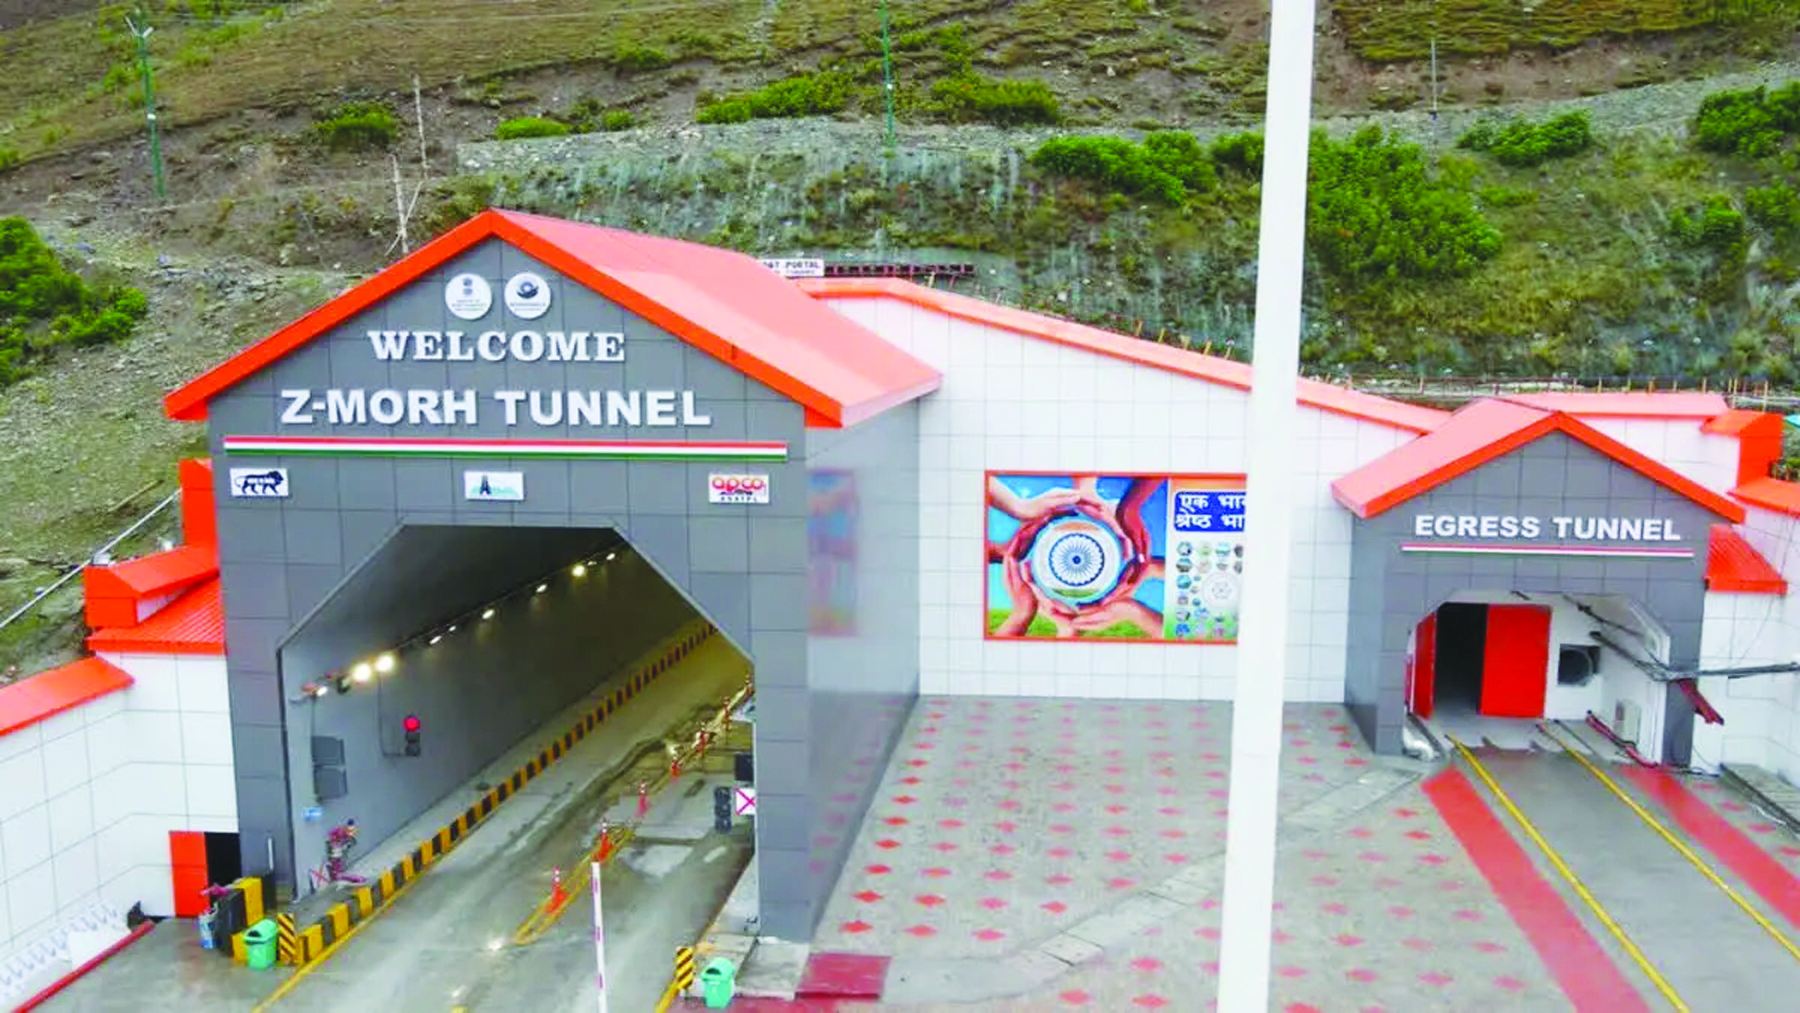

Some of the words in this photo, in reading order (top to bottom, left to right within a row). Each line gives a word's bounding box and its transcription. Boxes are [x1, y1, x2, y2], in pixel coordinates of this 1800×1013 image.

[785, 261, 820, 269] PORTAL
[368, 330, 626, 362] WELCOME
[280, 389, 478, 425] Z-MORH
[494, 390, 712, 426] TUNNEL
[1178, 494, 1209, 513] एक
[1221, 514, 1245, 529] भा
[1415, 515, 1540, 538] EGRESS
[1553, 517, 1681, 541] TUNNEL
